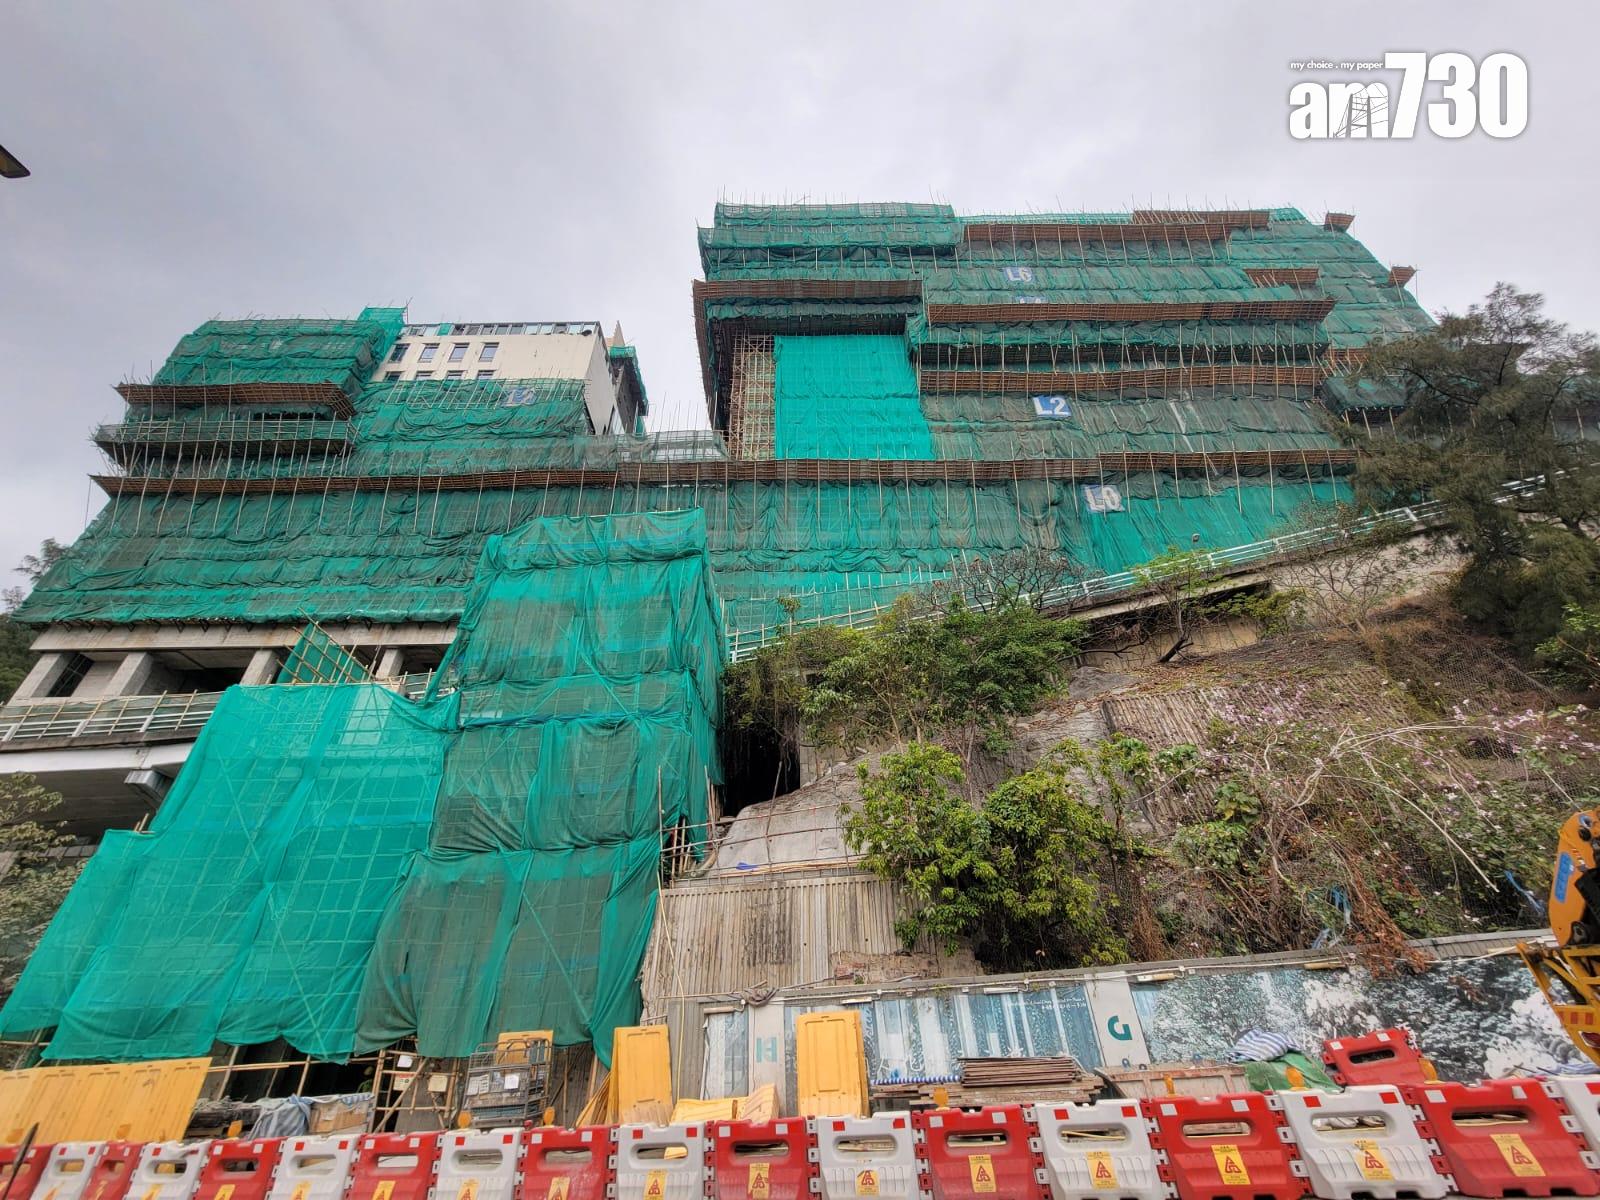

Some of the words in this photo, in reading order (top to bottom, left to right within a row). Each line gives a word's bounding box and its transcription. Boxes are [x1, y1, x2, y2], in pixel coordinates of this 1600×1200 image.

[1006, 267, 1032, 282] L6
[1033, 397, 1070, 415] L2
[1107, 1015, 1133, 1040] G
[756, 1037, 777, 1062] H
